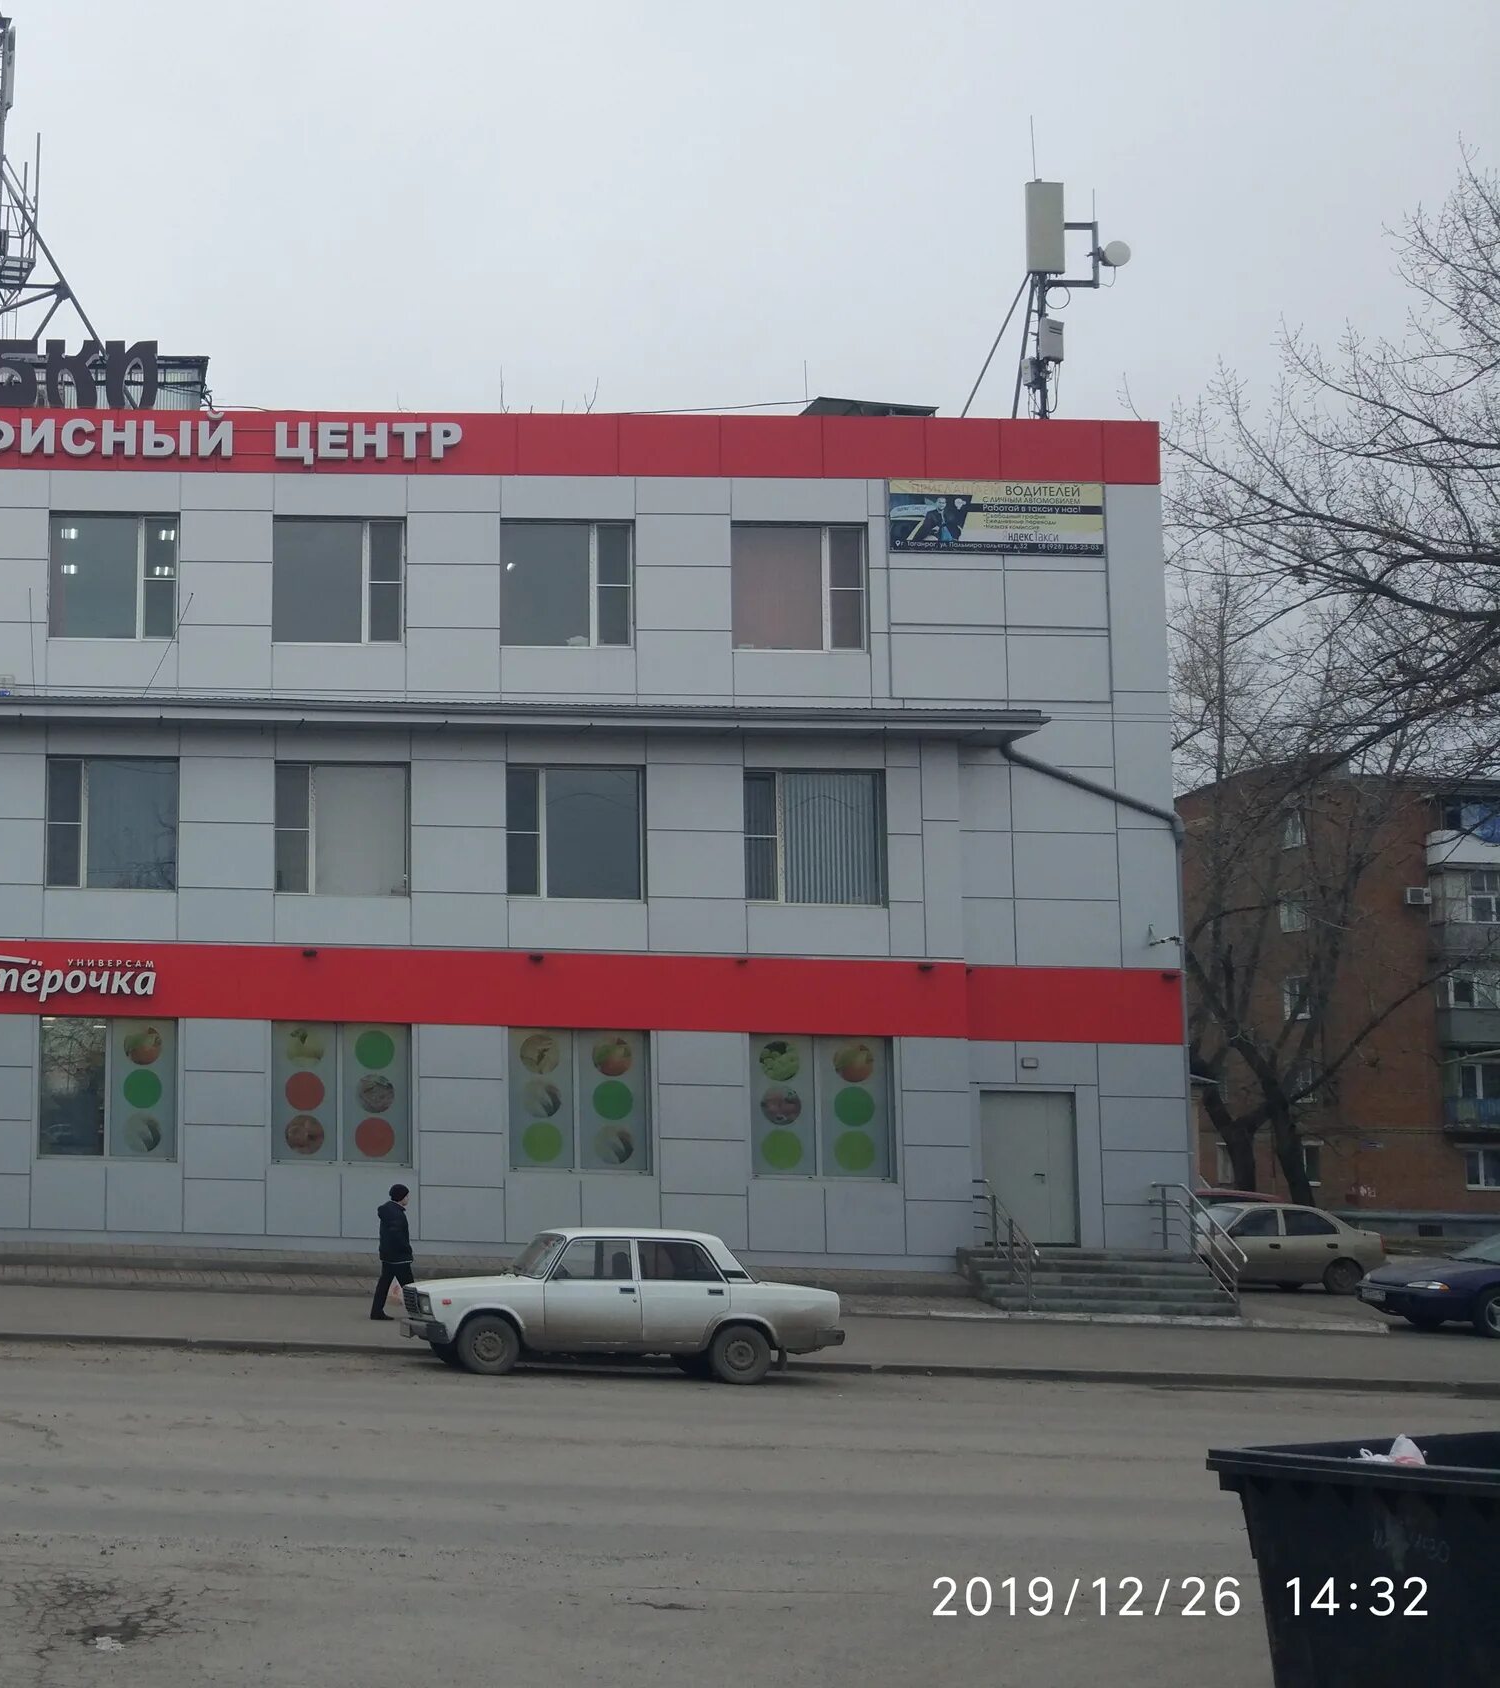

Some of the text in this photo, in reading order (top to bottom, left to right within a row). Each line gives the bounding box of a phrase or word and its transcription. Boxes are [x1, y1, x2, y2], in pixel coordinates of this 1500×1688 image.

[274, 421, 463, 469] ЦЕНТР
[1005, 485, 1080, 497] ВОДИТЕЛЕЙ
[1023, 497, 1080, 505] АВТОМОБИЛЕМ
[982, 504, 1019, 512] Работай
[67, 958, 155, 968] УНИВЕРСАМ
